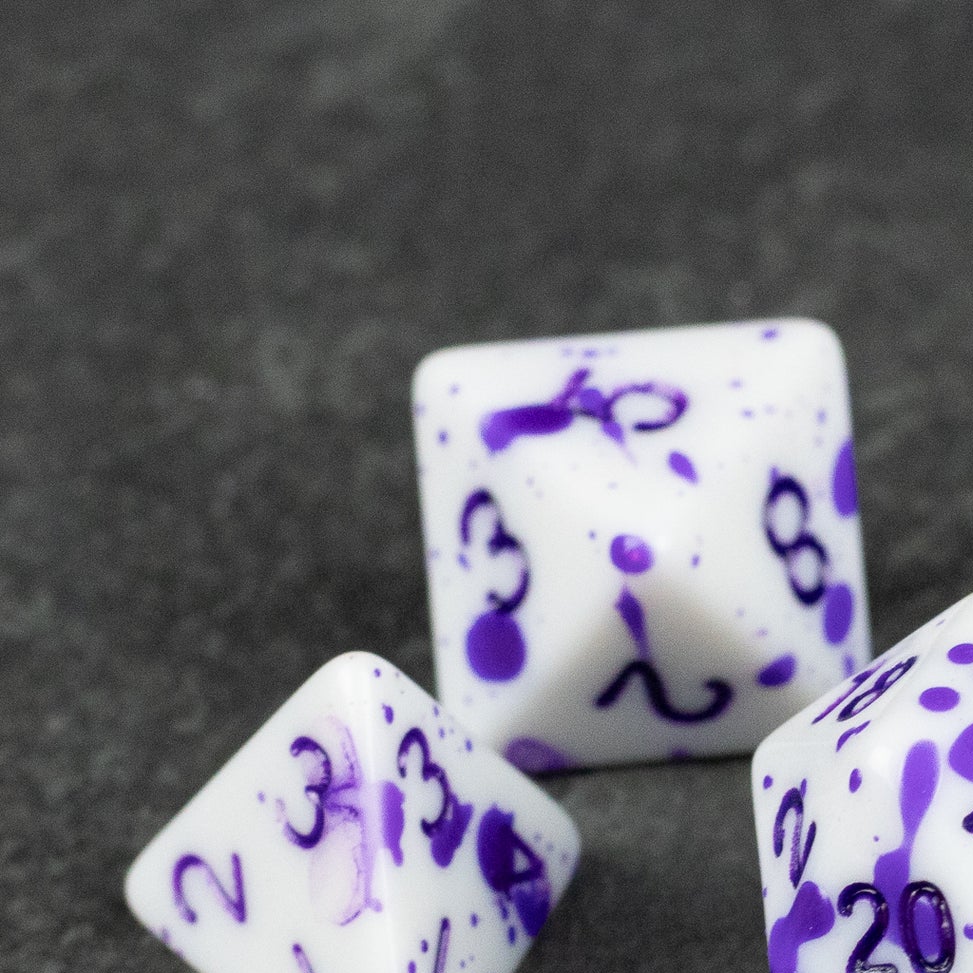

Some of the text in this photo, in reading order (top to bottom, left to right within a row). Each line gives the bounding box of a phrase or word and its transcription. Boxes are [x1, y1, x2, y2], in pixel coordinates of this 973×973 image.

[461, 489, 530, 614] 3
[764, 475, 829, 606] 8
[594, 660, 735, 723] 2
[276, 736, 332, 850] 3
[398, 727, 452, 839] 3
[772, 787, 817, 889] 2
[172, 853, 247, 924] 2
